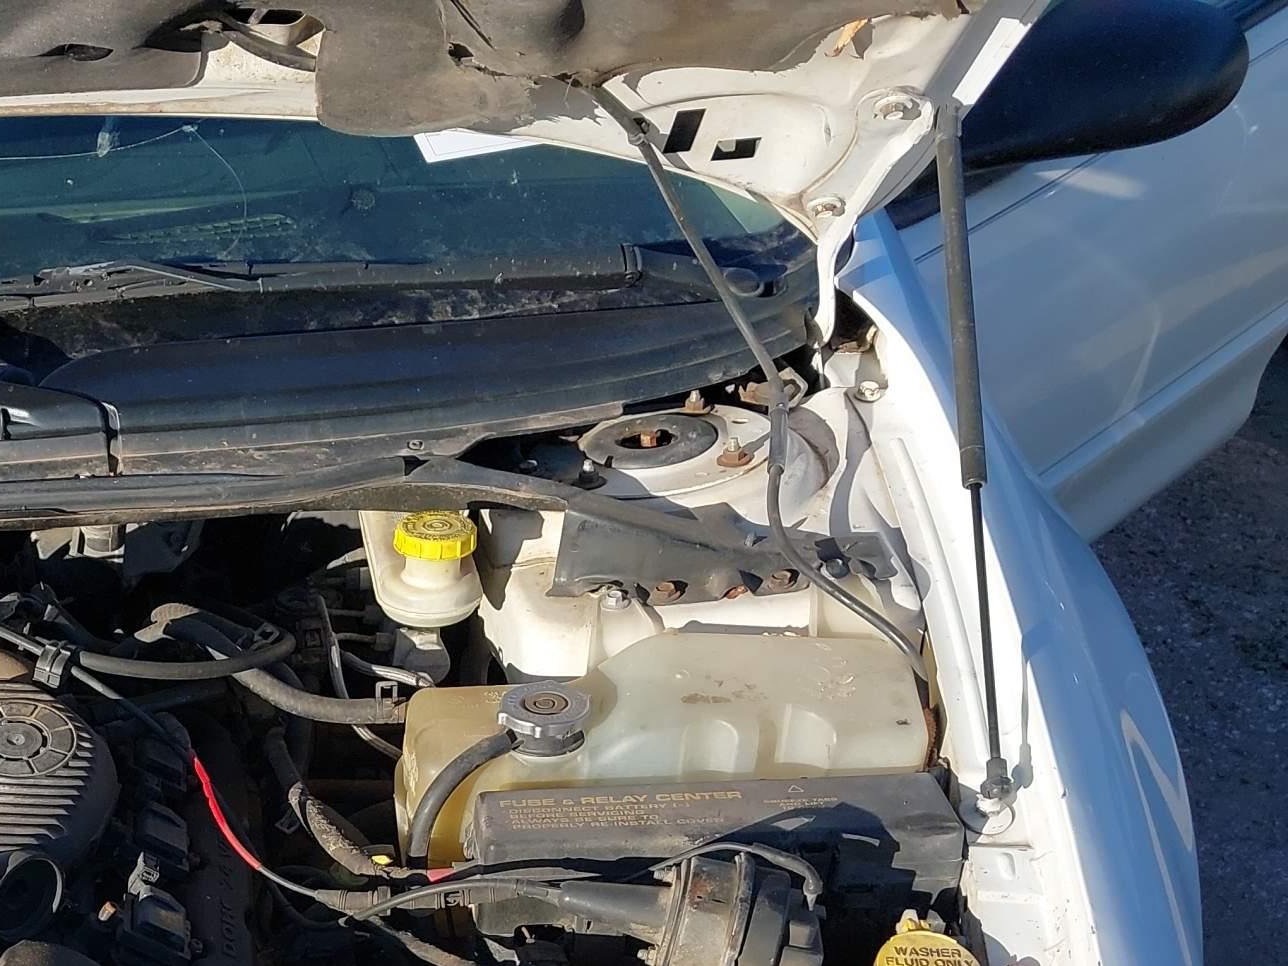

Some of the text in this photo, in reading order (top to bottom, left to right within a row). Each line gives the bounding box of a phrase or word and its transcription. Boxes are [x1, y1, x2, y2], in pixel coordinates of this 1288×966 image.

[499, 798, 554, 807] FUSE
[580, 794, 649, 804] RELAY
[655, 791, 743, 801] CENTER
[894, 946, 961, 958] WASHER
